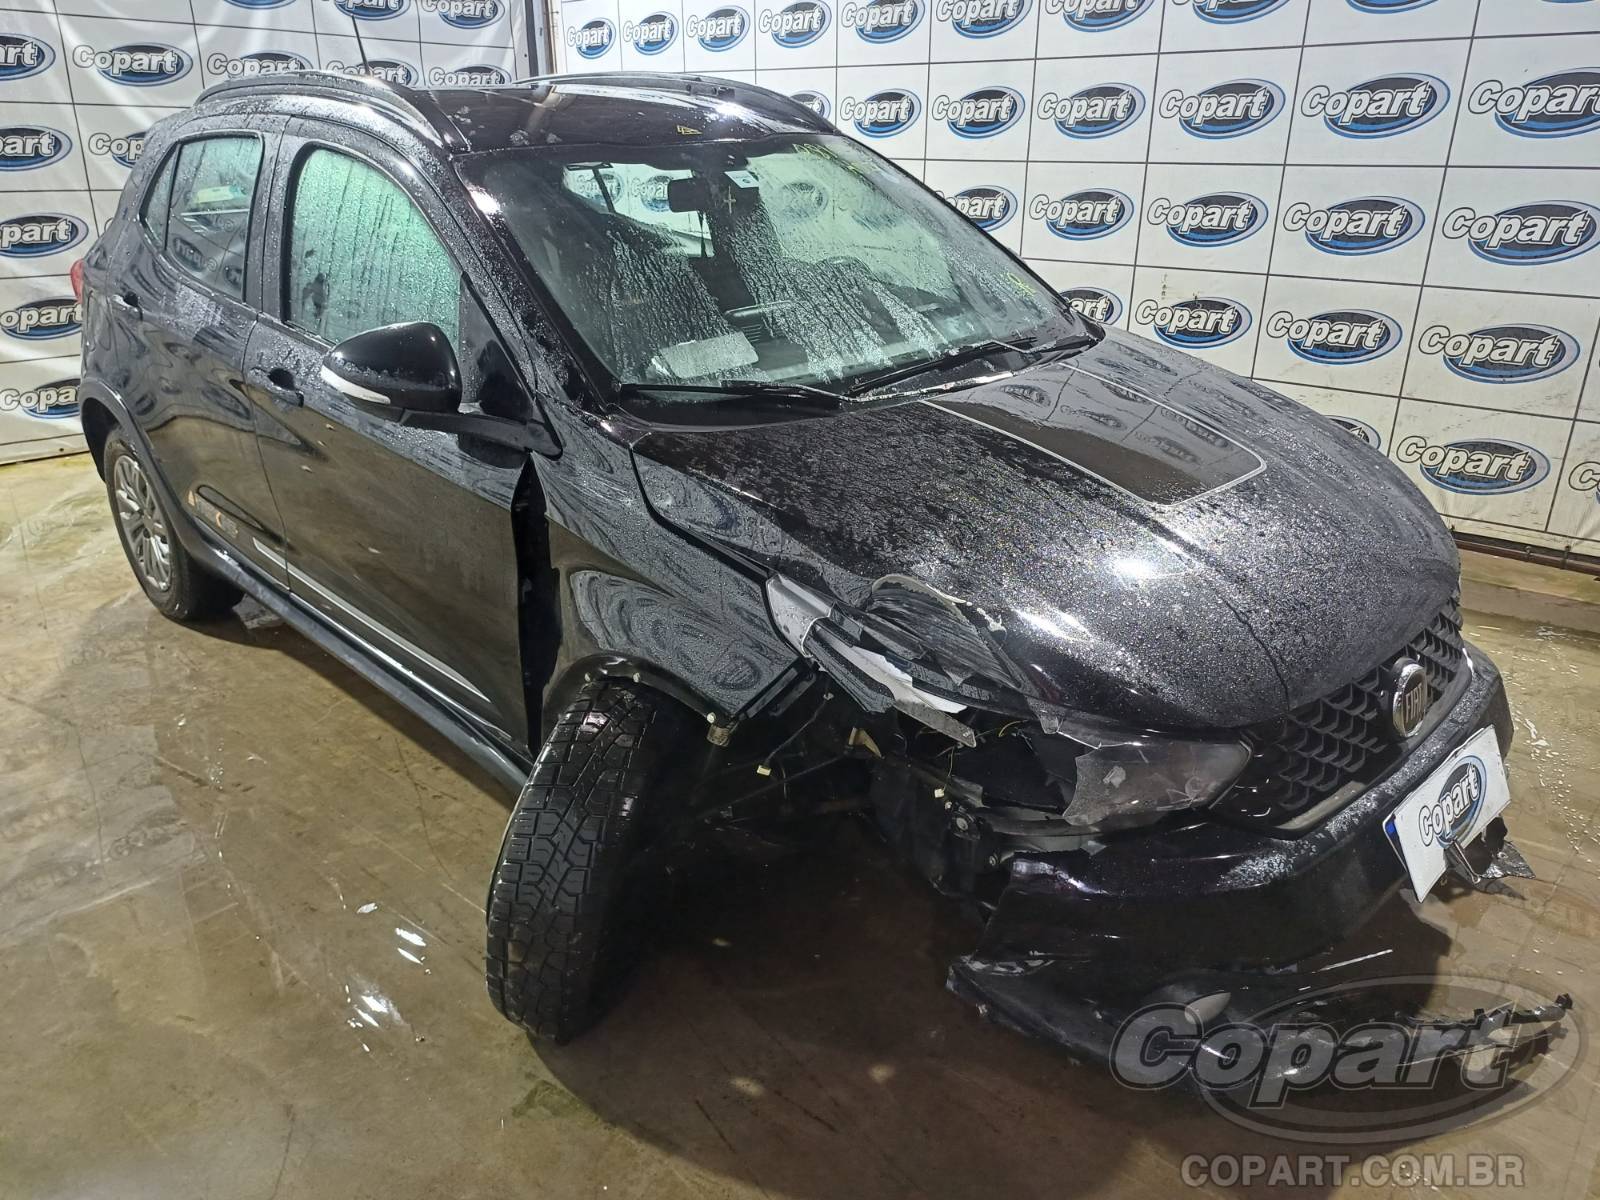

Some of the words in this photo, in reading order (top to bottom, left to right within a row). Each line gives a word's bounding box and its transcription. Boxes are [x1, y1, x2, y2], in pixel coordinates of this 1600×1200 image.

[686, 12, 742, 45] Copart
[759, 5, 823, 39] Copart
[841, 2, 913, 33] Copart
[936, 0, 1018, 28] Copart
[567, 25, 609, 51] Copart
[623, 19, 673, 48] Copart
[73, 44, 178, 76] Copart
[840, 96, 911, 127] Copart
[932, 92, 1011, 127] Copart
[1037, 88, 1134, 127] Copart
[1159, 86, 1270, 127] Copart
[1301, 81, 1433, 125] Copart
[88, 132, 145, 161] Cop
[1029, 193, 1123, 229] Copart
[1147, 197, 1255, 235] Copart
[1283, 202, 1407, 241] Copart
[1442, 206, 1589, 251] Copart
[0, 218, 72, 250] part
[1135, 299, 1239, 335] Copart
[1265, 310, 1387, 351] Copart
[1418, 325, 1559, 369] Copart
[0, 388, 79, 414] Copa
[1396, 435, 1529, 481] Copart
[1405, 682, 1423, 724] FIAT
[1418, 762, 1479, 847] Copart
